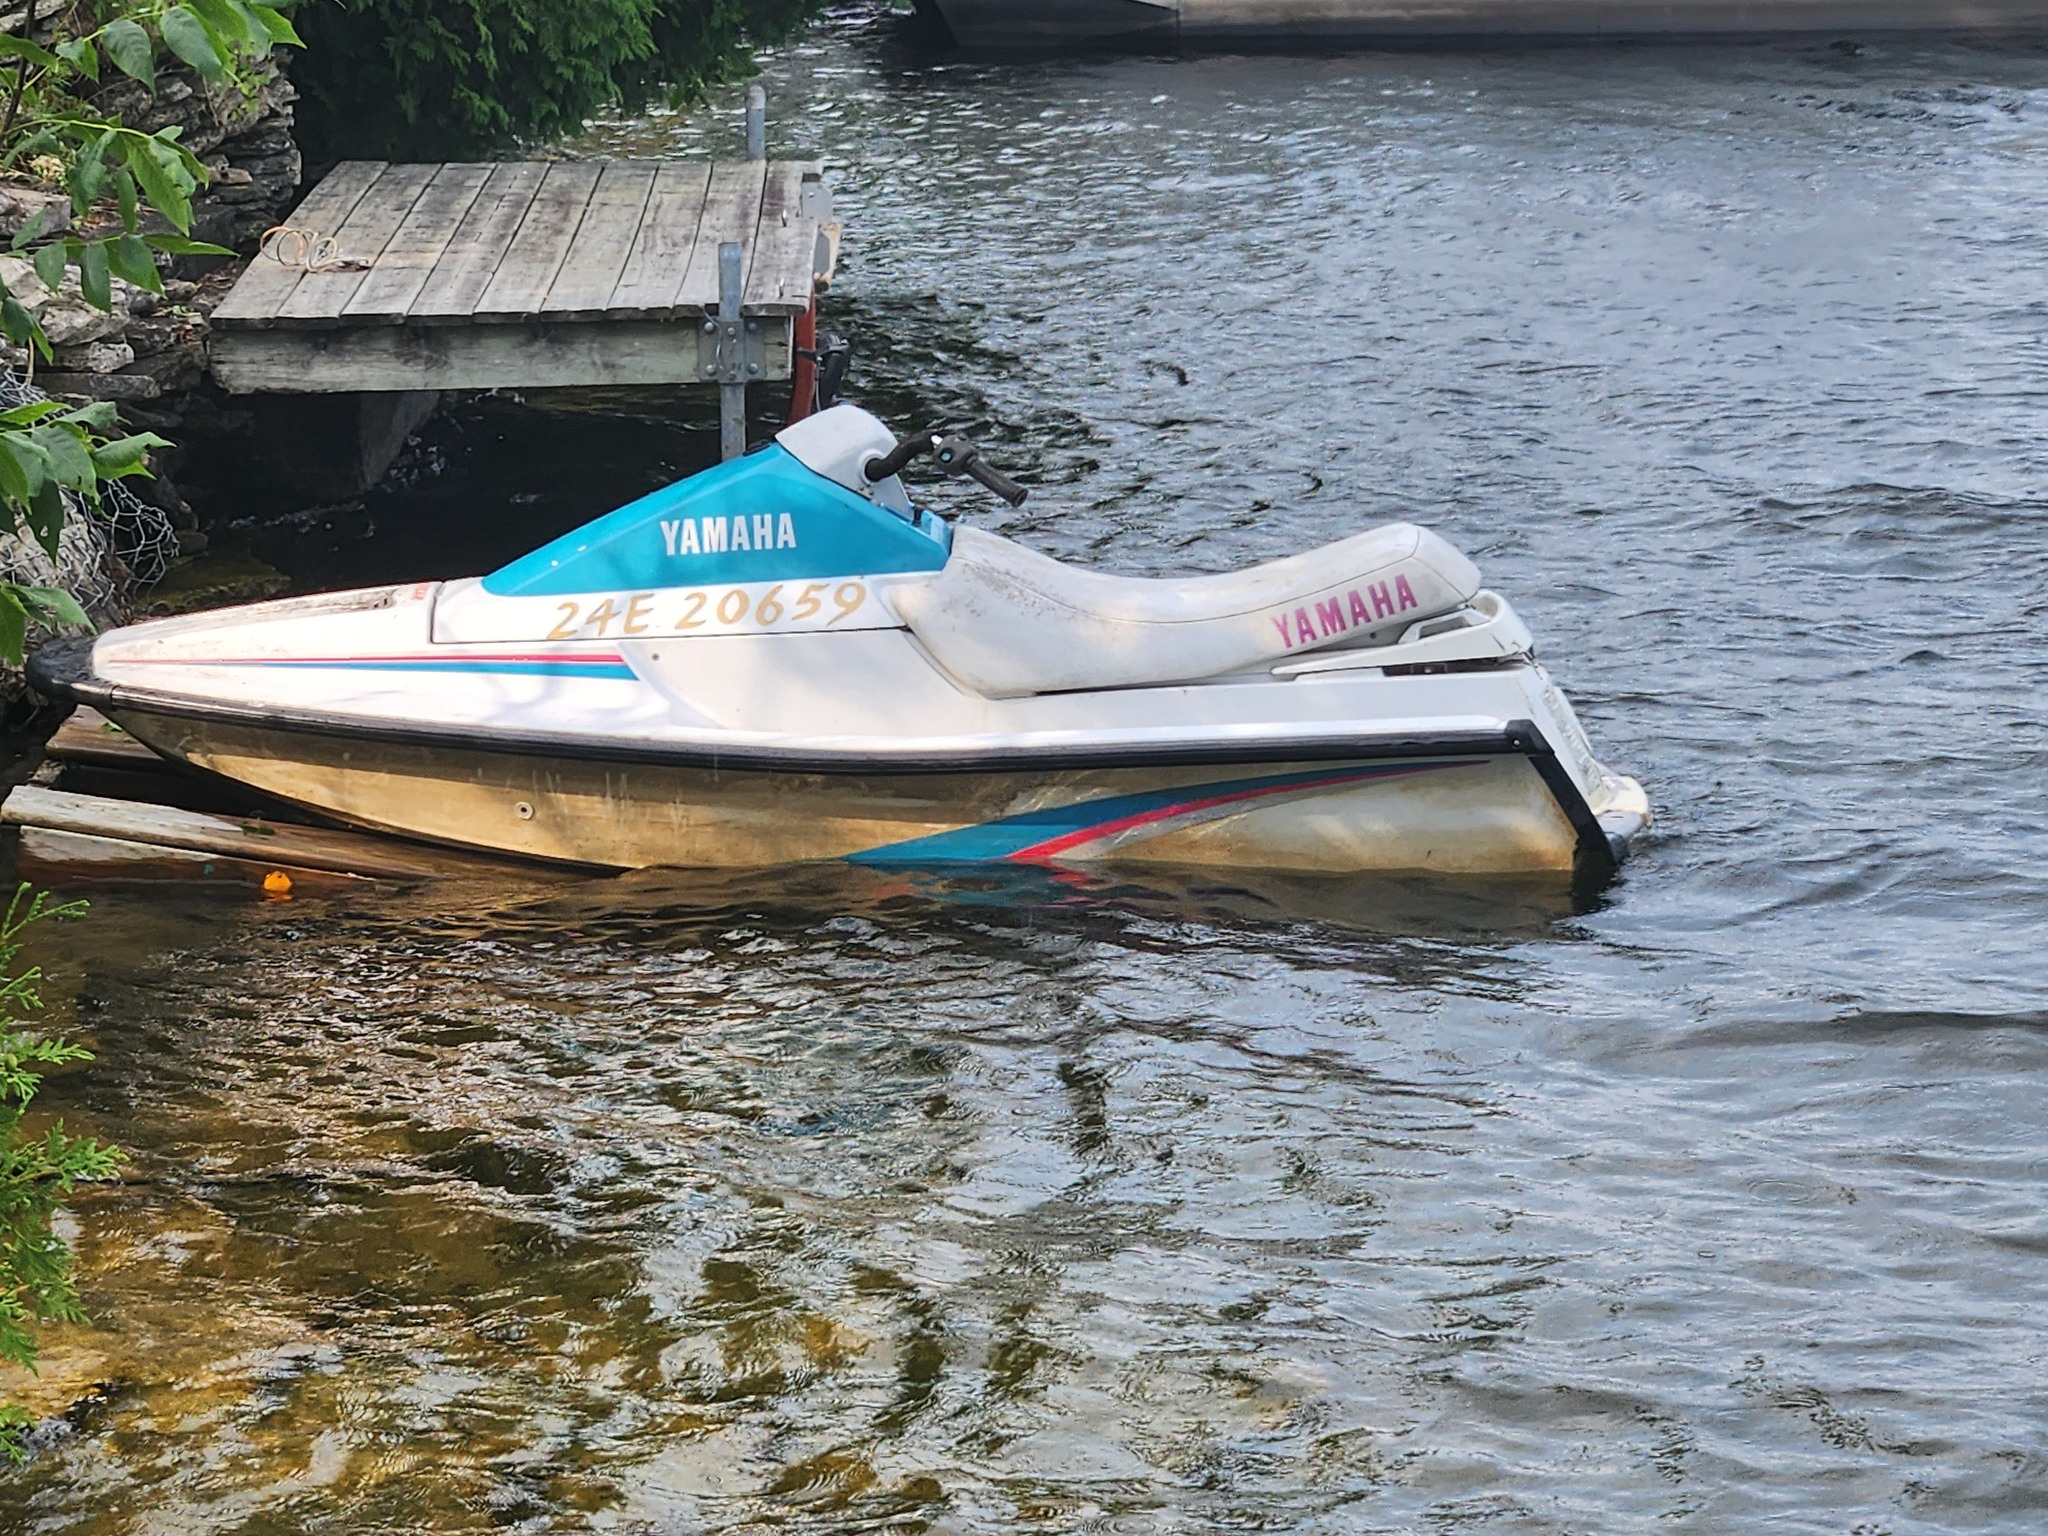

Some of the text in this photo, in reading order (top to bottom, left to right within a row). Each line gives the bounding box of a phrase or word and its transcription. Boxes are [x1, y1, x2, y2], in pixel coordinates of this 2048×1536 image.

[660, 513, 797, 556] YAMAHA
[548, 583, 867, 639] 24E 20659
[1271, 574, 1418, 649] YAMAHA
